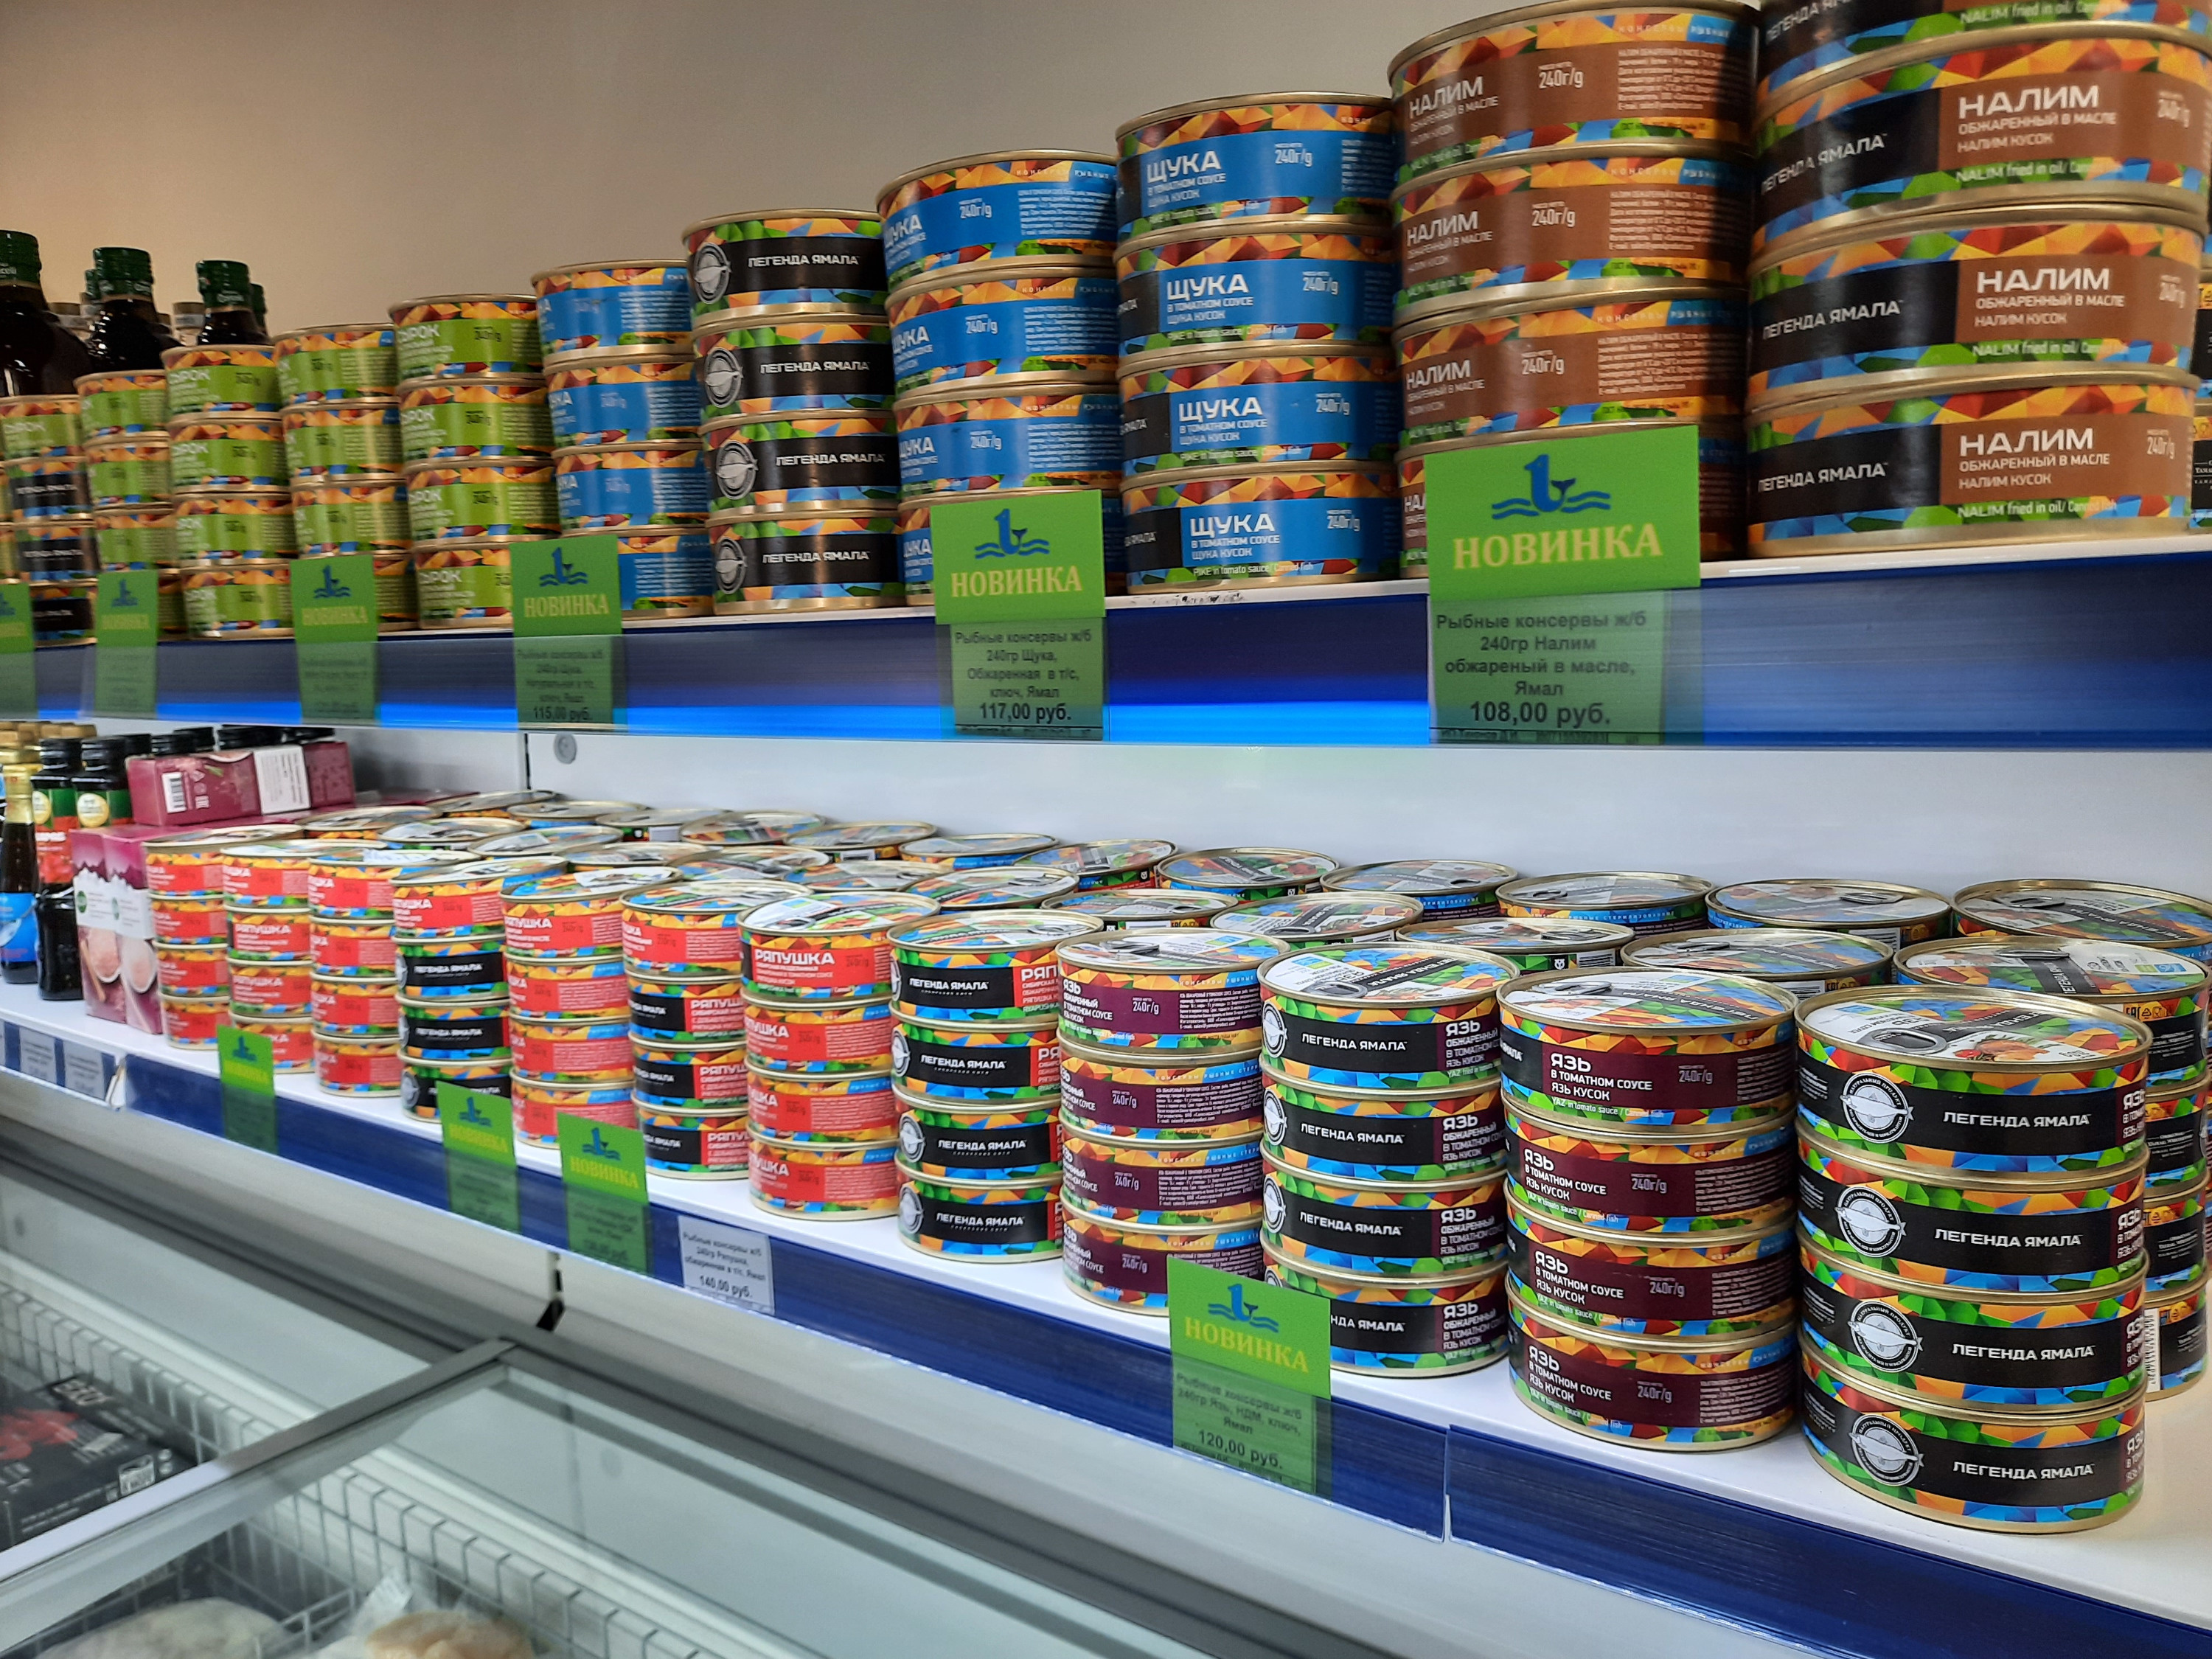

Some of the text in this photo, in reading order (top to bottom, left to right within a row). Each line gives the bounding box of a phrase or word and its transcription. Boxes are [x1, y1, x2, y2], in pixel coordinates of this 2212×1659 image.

[1409, 76, 1484, 119] НАЛИМ
[1958, 85, 2099, 119] НАЛИМ
[1958, 112, 2117, 135] ОБЖАРЕННЫЙ В МАСЛЕ
[1818, 134, 1885, 166] ЯМАЛА
[1958, 133, 2053, 153] НАЛИМ КУСОК
[1146, 150, 1222, 183] ЩУКА
[1406, 210, 1478, 248] НАЛИМ
[748, 255, 859, 268] ЛЕГЕНДА ЯМАЛА
[1166, 274, 1249, 302] ЩУКА
[1977, 268, 2110, 293] НАЛИМ
[1175, 299, 1221, 312] ТОМАТНОМ
[1223, 296, 1253, 307] СОУСЕ
[1975, 293, 2125, 310] ОБЖАРЕННЫЙ В МАСЛЕ
[1762, 302, 1901, 340] ЛЕГЕНДА ЯМАЛА
[1974, 313, 2067, 327] НАЛИМ КУСОК
[760, 361, 869, 374] ЛЕГЕНДА ЯМАЛА
[1405, 360, 1471, 390] НАЛИМ
[1178, 396, 1263, 422] ЩУКА
[1187, 421, 1236, 434] ТОМАТНОМ
[1238, 419, 1267, 430] СОУСЕ
[1960, 428, 2093, 456] НАЛИМ
[776, 453, 884, 466] ЛЕГЕНДА ЯМАЛА
[1959, 453, 2110, 472] ОБЖАРЕННЫЙ В МАСЛЕ
[1758, 462, 1886, 493] ЛЕГЕНДА ЯМАЛА
[1959, 473, 2051, 490] НАЛИМ КУСОК
[1189, 513, 1276, 538] ЩУКА
[1199, 536, 1248, 549] ТОМАТНОМ
[1250, 535, 1280, 545] СОУСЕ
[1453, 523, 1663, 570] НОВИНКА
[762, 552, 869, 563] ЛЕГЕНДА ЯМАЛА
[1192, 547, 1252, 560] ЩУКА КУСОК
[951, 566, 1083, 597] НОВИНКА
[524, 594, 610, 618] НОВИНКА
[1437, 611, 1646, 630] Рыбные консервы ж/б
[956, 632, 1004, 644] Рыбные
[1481, 636, 1596, 654] 240гр Налим
[1022, 650, 1057, 663] Щука,
[967, 668, 1040, 681] Обжаренная
[1048, 670, 1054, 680] в
[1554, 663, 1564, 673] в
[1571, 662, 1635, 675] масле,
[1027, 686, 1059, 698] Ямал
[1514, 681, 1562, 696] Ямал
[980, 703, 1071, 724] 117,00 руб.
[1470, 701, 1610, 728] 108,00 руб.
[754, 948, 835, 965] РЯПУШКА
[909, 978, 988, 990] ЛЕГЕНДА ЯМАЛА
[1063, 978, 1081, 995] ЯЗЬ
[1133, 1001, 1159, 1015] 240г/g
[1445, 1020, 1481, 1037] ЯЗЬ
[1445, 1028, 1498, 1048] ОБЖАРЕННЫЙ
[1301, 1034, 1406, 1051] ЛЕГЕНДА ЯМАЛА
[1446, 1043, 1493, 1058] В ТОМАТНОМ
[921, 1055, 1005, 1069] ЛЕГЕНДА ЯМАЛА
[1551, 1053, 1591, 1072] ЯЗЬ
[1551, 1069, 1652, 1090] В ТОМАТНОМ СОУСЕ
[1112, 1093, 1137, 1108] 240г/g
[1552, 1082, 1610, 1101] ЯЗЬ КУСОК
[1442, 1113, 1478, 1130] ЯЗЬ
[1943, 1111, 2090, 1128] ЛЕГЕНДА ЯМАЛА
[1301, 1122, 1404, 1144] ЛЕГЕНДА ЯМАЛА
[1442, 1121, 1497, 1142] ОБЖАРЕННЫЙ
[938, 1140, 1026, 1151] ЛЕГЕНДА ЯМАЛА
[1524, 1149, 1554, 1171] ЯЗЬ
[569, 1156, 639, 1189] НОВИНКА
[1525, 1164, 1607, 1194] В ТОМАТНОМ СОУСЕ
[1115, 1175, 1140, 1191] 240г/g
[1526, 1176, 1570, 1201] ЯЗЬ КУСОК
[1632, 1178, 1667, 1194] 240г/g
[936, 1213, 1023, 1225] ЛЕГЕНДА ЯМАЛА
[1300, 1212, 1402, 1236] ЛЕГЕНДА ЯМАЛА
[1441, 1208, 1477, 1224] ЯЗЬ
[1935, 1228, 2081, 1248] ЛЕГЕНДА ЯМАЛА
[1121, 1256, 1148, 1273] 240г/g
[1535, 1251, 1568, 1274] ЯЗЬ
[700, 1275, 752, 1298] 140,00 руб.
[1536, 1266, 1624, 1298] В ТОМАТНОМ СОУСЕ
[1649, 1281, 1685, 1297] 240г/g
[1443, 1303, 1478, 1319] ЯЗЬ
[1358, 1321, 1404, 1332] ЯМАЛА
[1185, 1317, 1309, 1374] НОВИНКА
[1952, 1343, 2094, 1360] ЛЕГЕНДА ЯМАЛА
[1529, 1346, 1559, 1372] ЯЗЬ
[1177, 1372, 1221, 1395] Рыбные
[1529, 1360, 1612, 1400] В ТОМАТНОМ СОУСЕ
[1529, 1373, 1575, 1403] ЯЗЬ КУСОК
[1638, 1385, 1672, 1403] 240г/g
[1222, 1416, 1253, 1435] Ямал
[1198, 1429, 1283, 1470] 120,00 руб.
[1952, 1461, 2093, 1480] ЛЕГЕНДА ЯМАЛА
